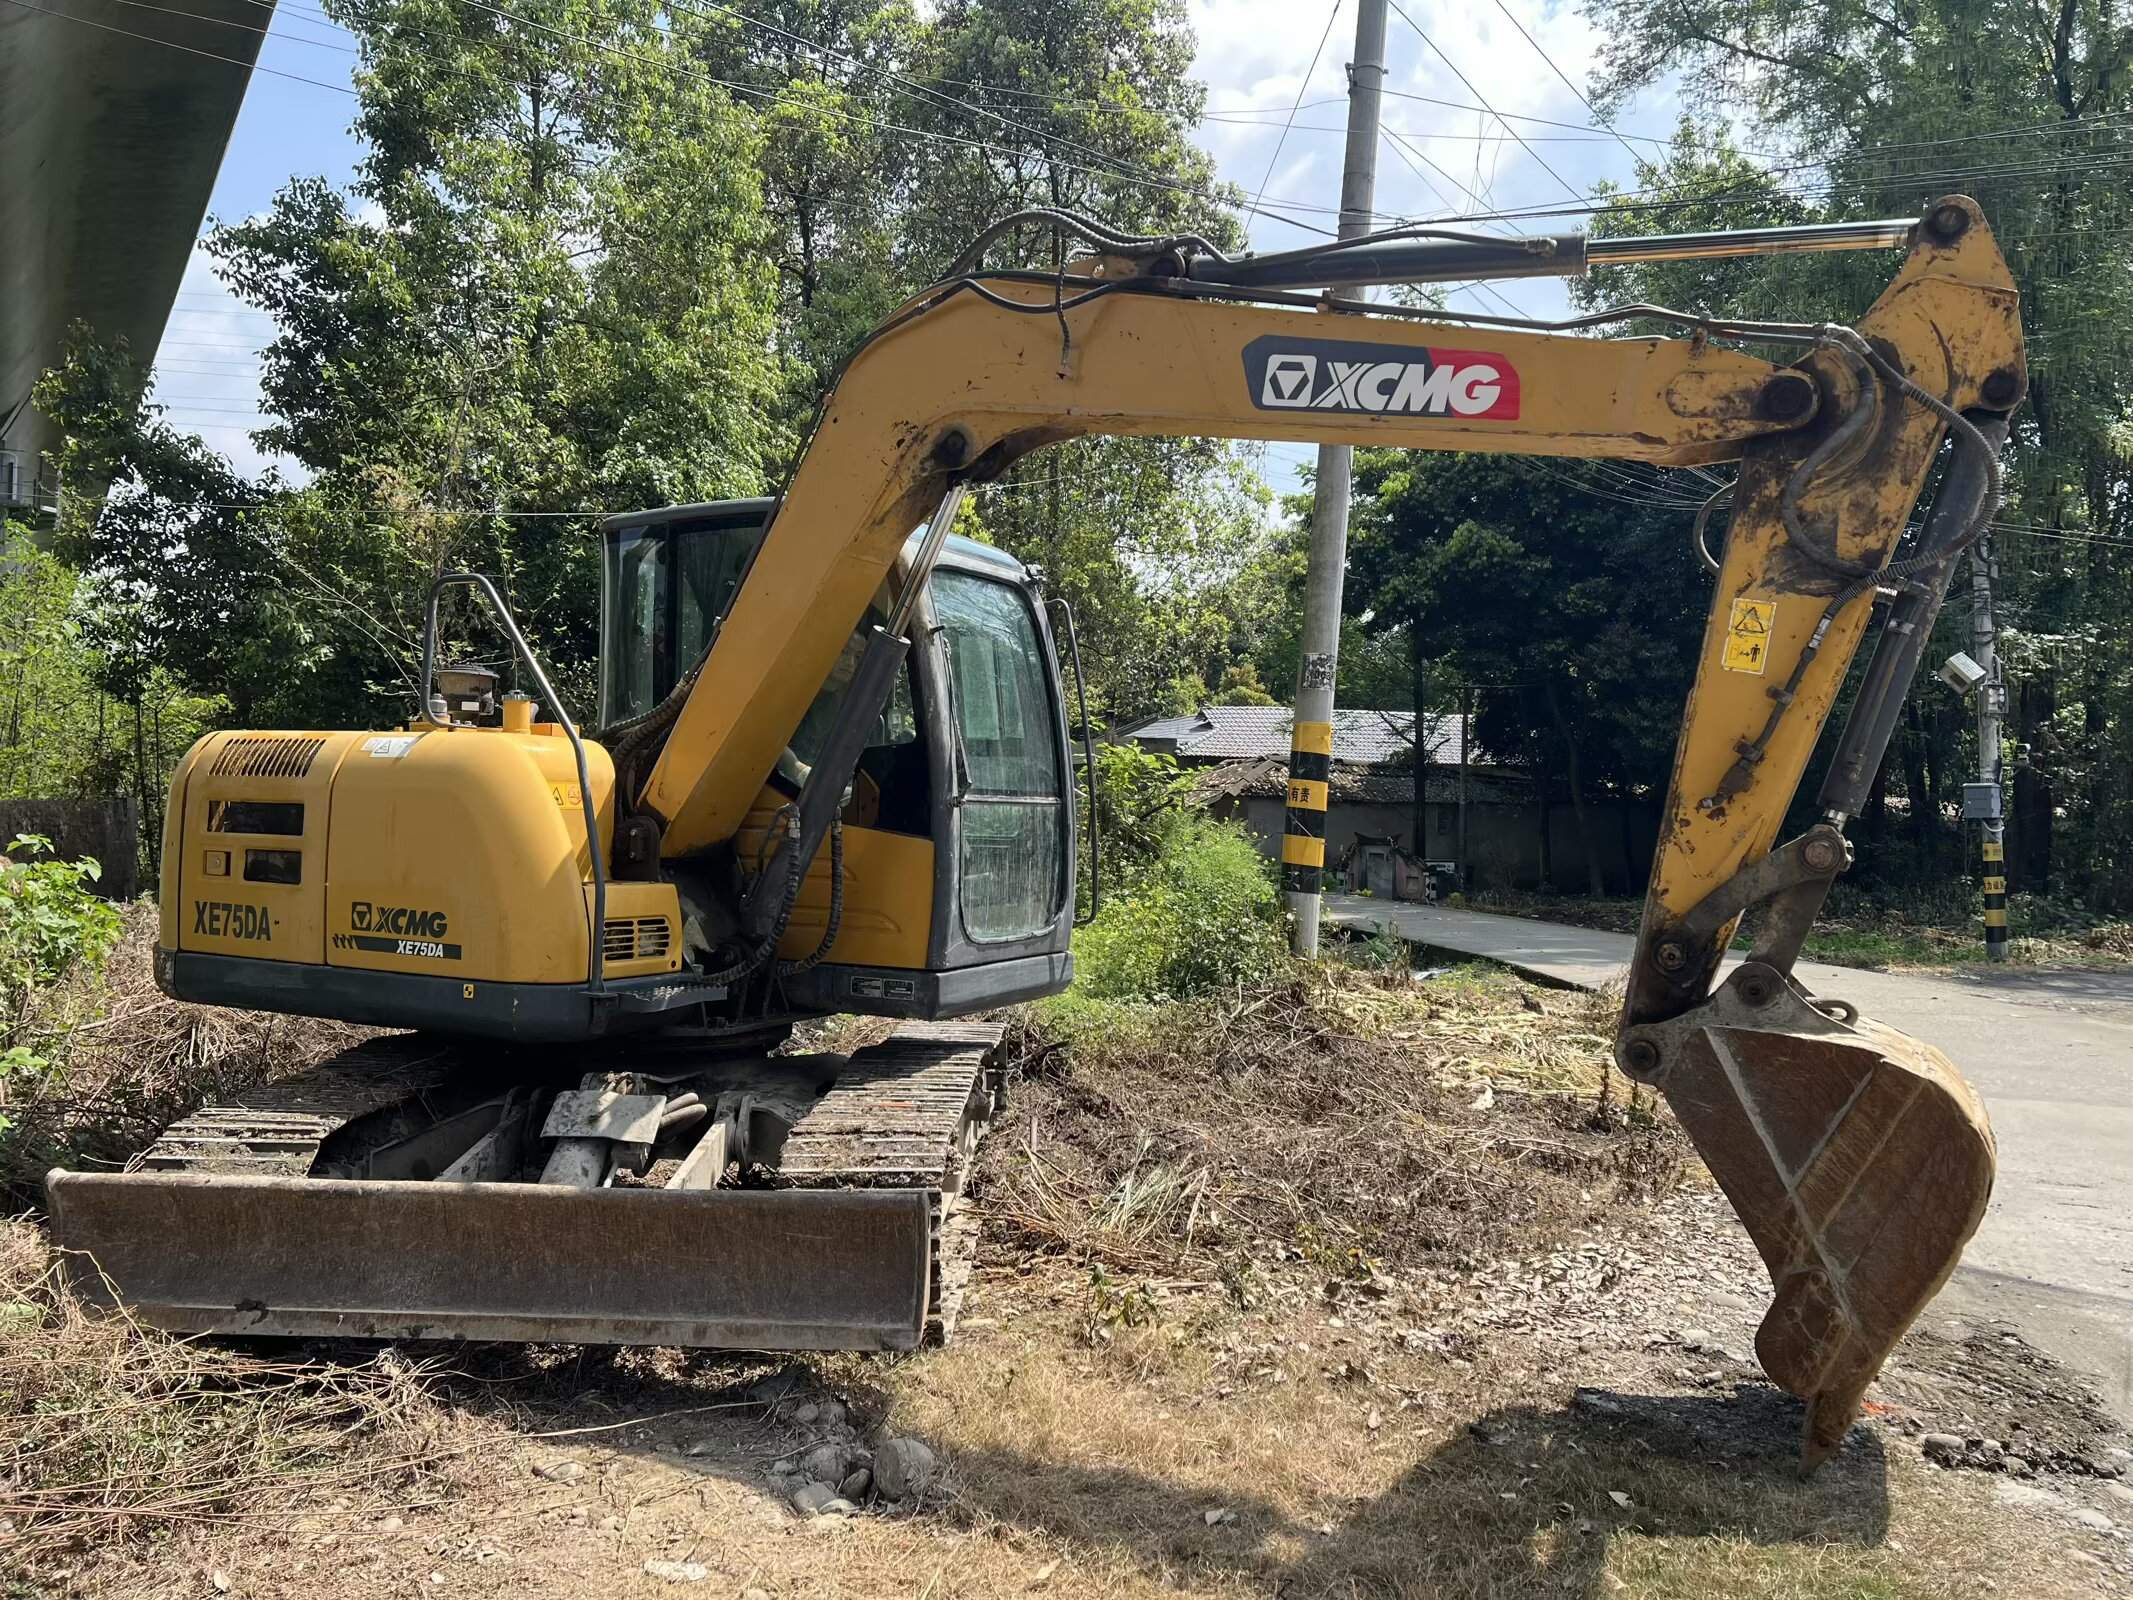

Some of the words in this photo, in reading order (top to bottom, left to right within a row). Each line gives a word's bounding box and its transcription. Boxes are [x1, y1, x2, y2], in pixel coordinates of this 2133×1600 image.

[1309, 361, 1501, 415] XCMG
[1288, 784, 1310, 803] 有责
[194, 901, 271, 942] XE75DA
[372, 906, 448, 939] XCMG
[396, 940, 444, 958] XE75DA
